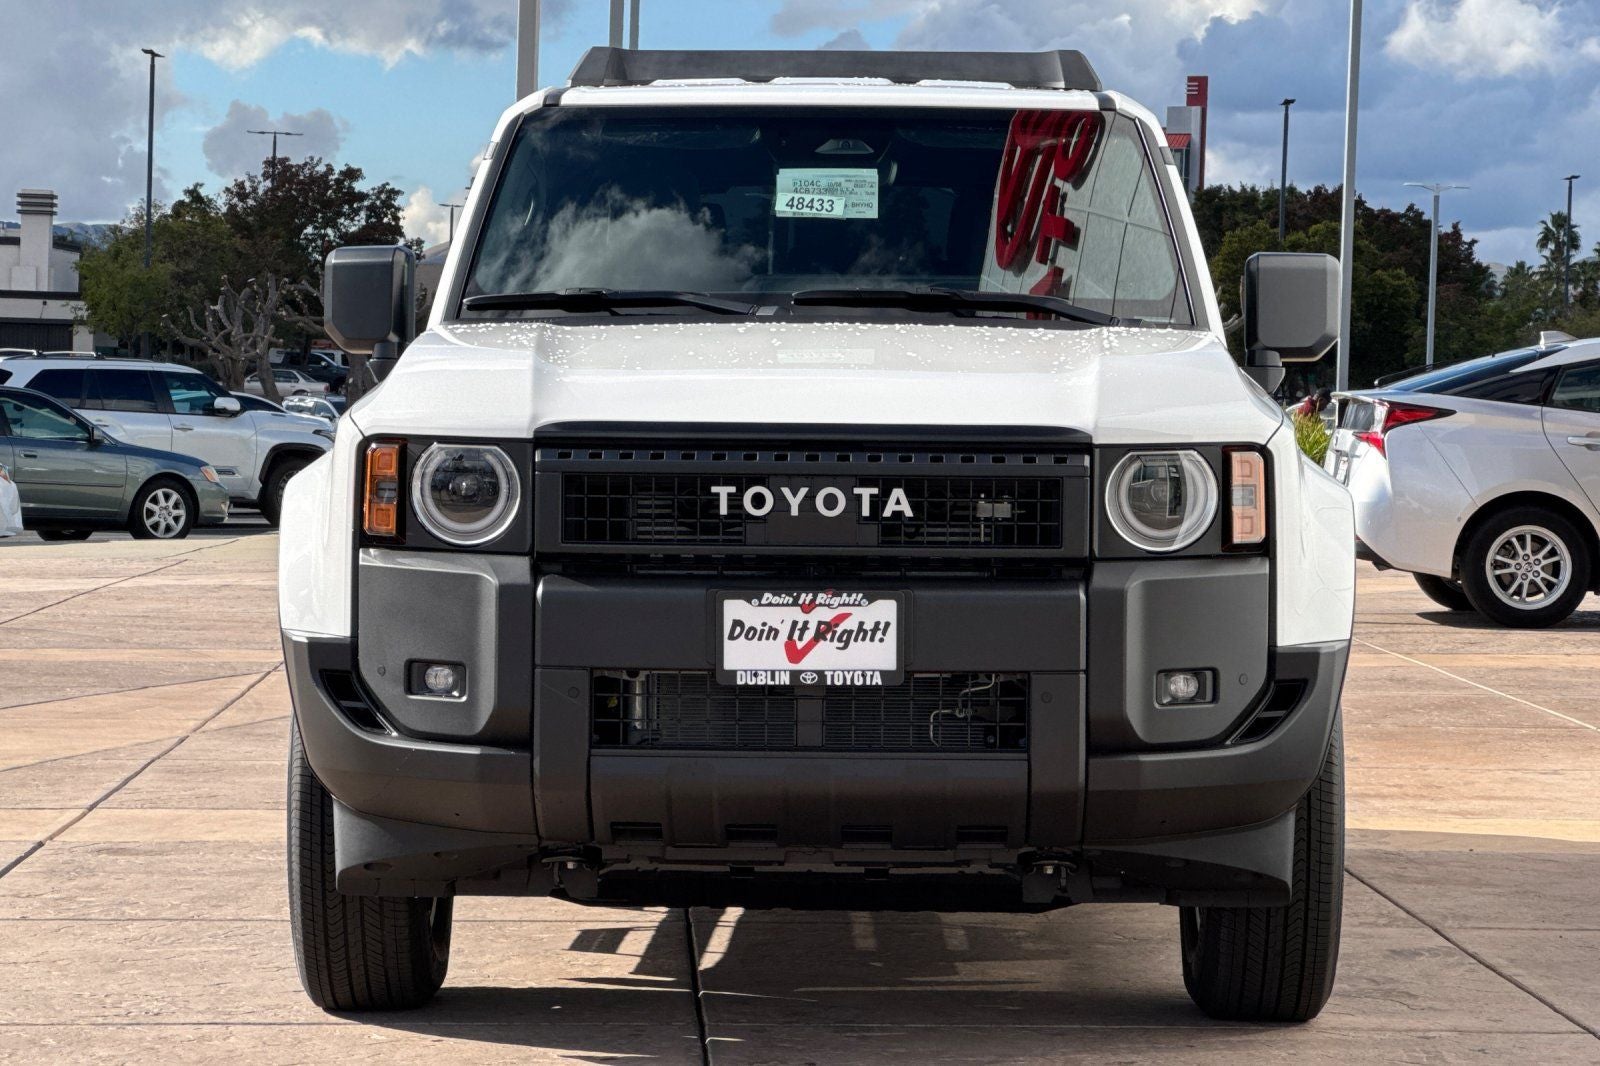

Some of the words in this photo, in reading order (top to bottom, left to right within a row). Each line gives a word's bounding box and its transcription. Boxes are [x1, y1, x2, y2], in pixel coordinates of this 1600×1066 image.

[785, 196, 835, 213] 48433
[710, 485, 914, 518] TOYOTA
[761, 592, 797, 605] Doin'
[798, 592, 815, 605] It
[816, 592, 864, 609] Right!
[727, 618, 785, 642] Doin'
[787, 619, 810, 642] It
[813, 620, 892, 651] Right!
[736, 670, 790, 685] DUBLIN
[824, 670, 882, 685] TOYOTA
